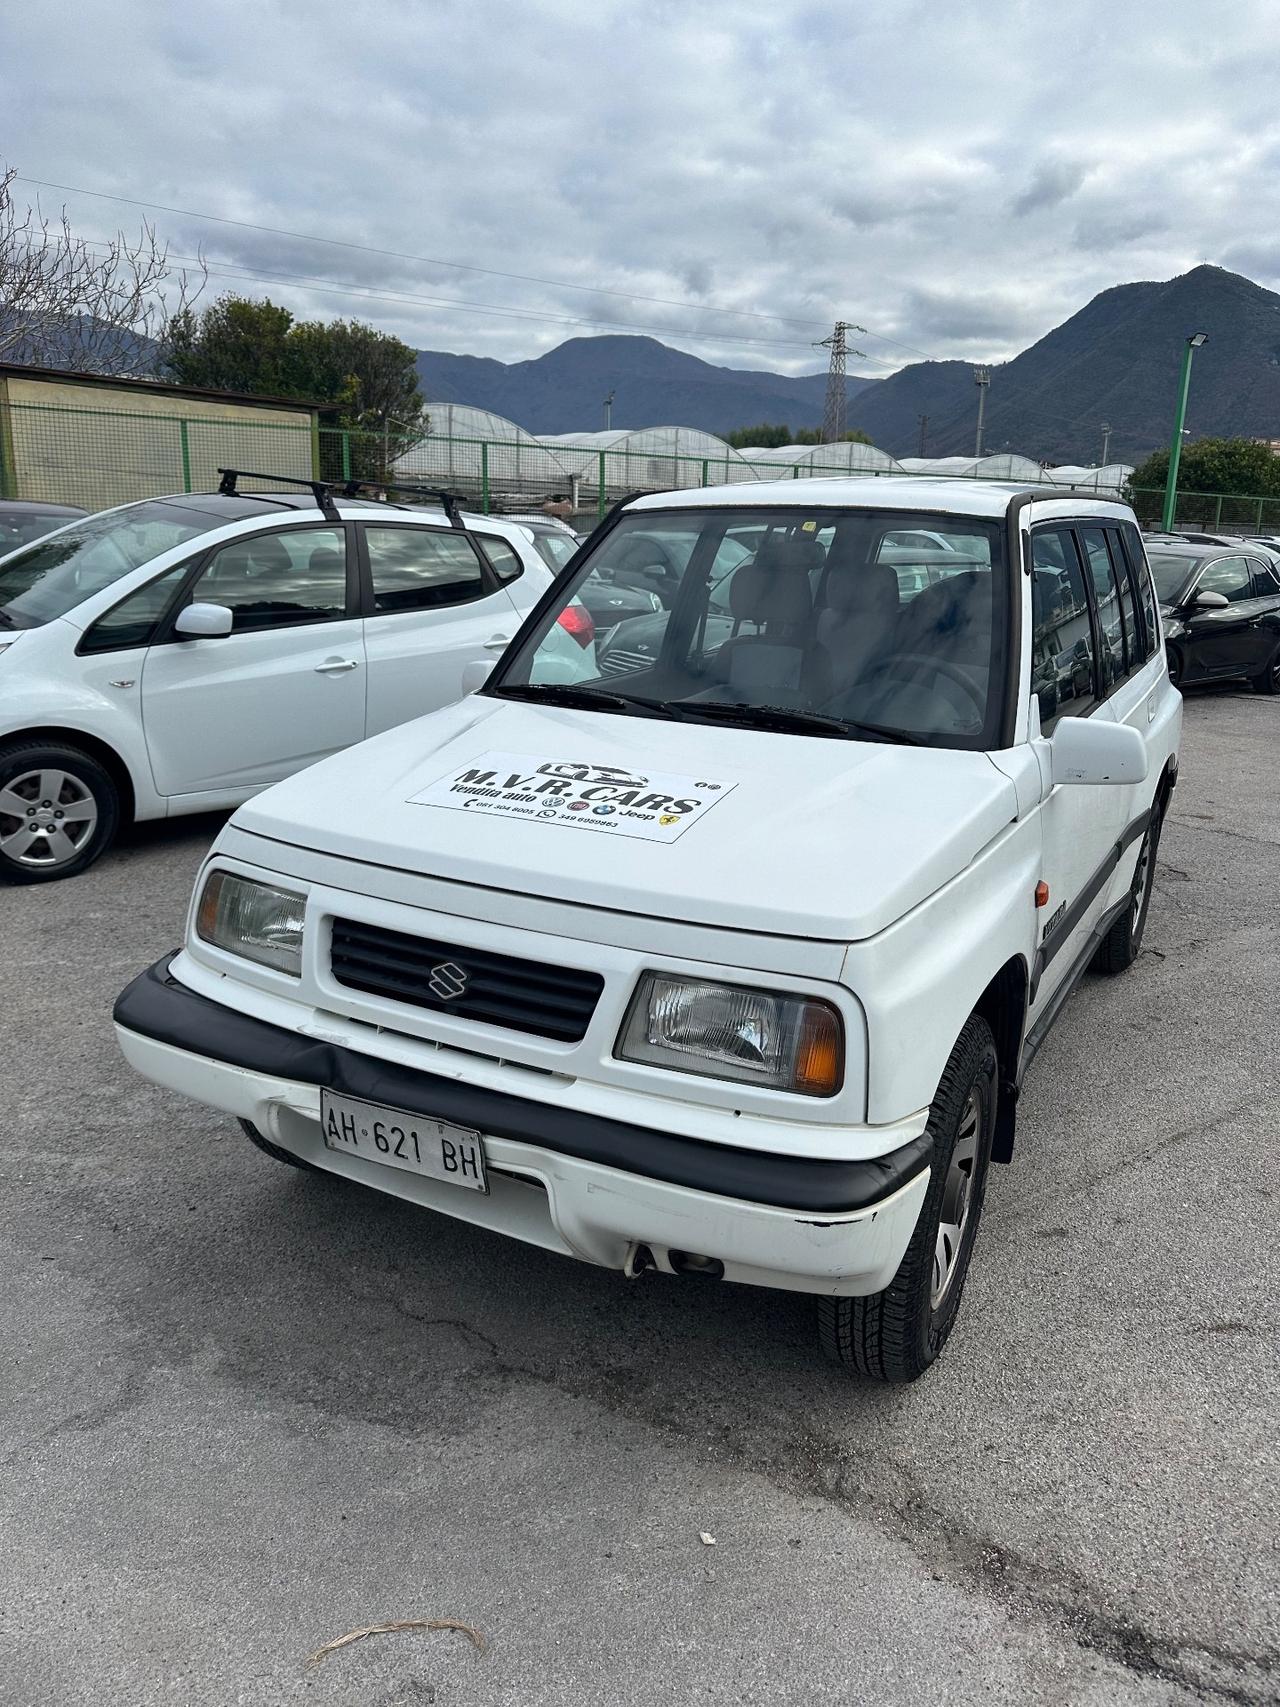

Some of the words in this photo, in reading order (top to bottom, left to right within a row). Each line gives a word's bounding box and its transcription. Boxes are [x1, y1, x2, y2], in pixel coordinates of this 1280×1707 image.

[450, 784, 502, 798] Vendita
[502, 792, 537, 802] auto
[558, 813, 577, 821] 349
[619, 810, 656, 821] Jeep
[328, 1108, 358, 1145] AH
[373, 1121, 422, 1163] 621
[441, 1138, 479, 1179] BH
